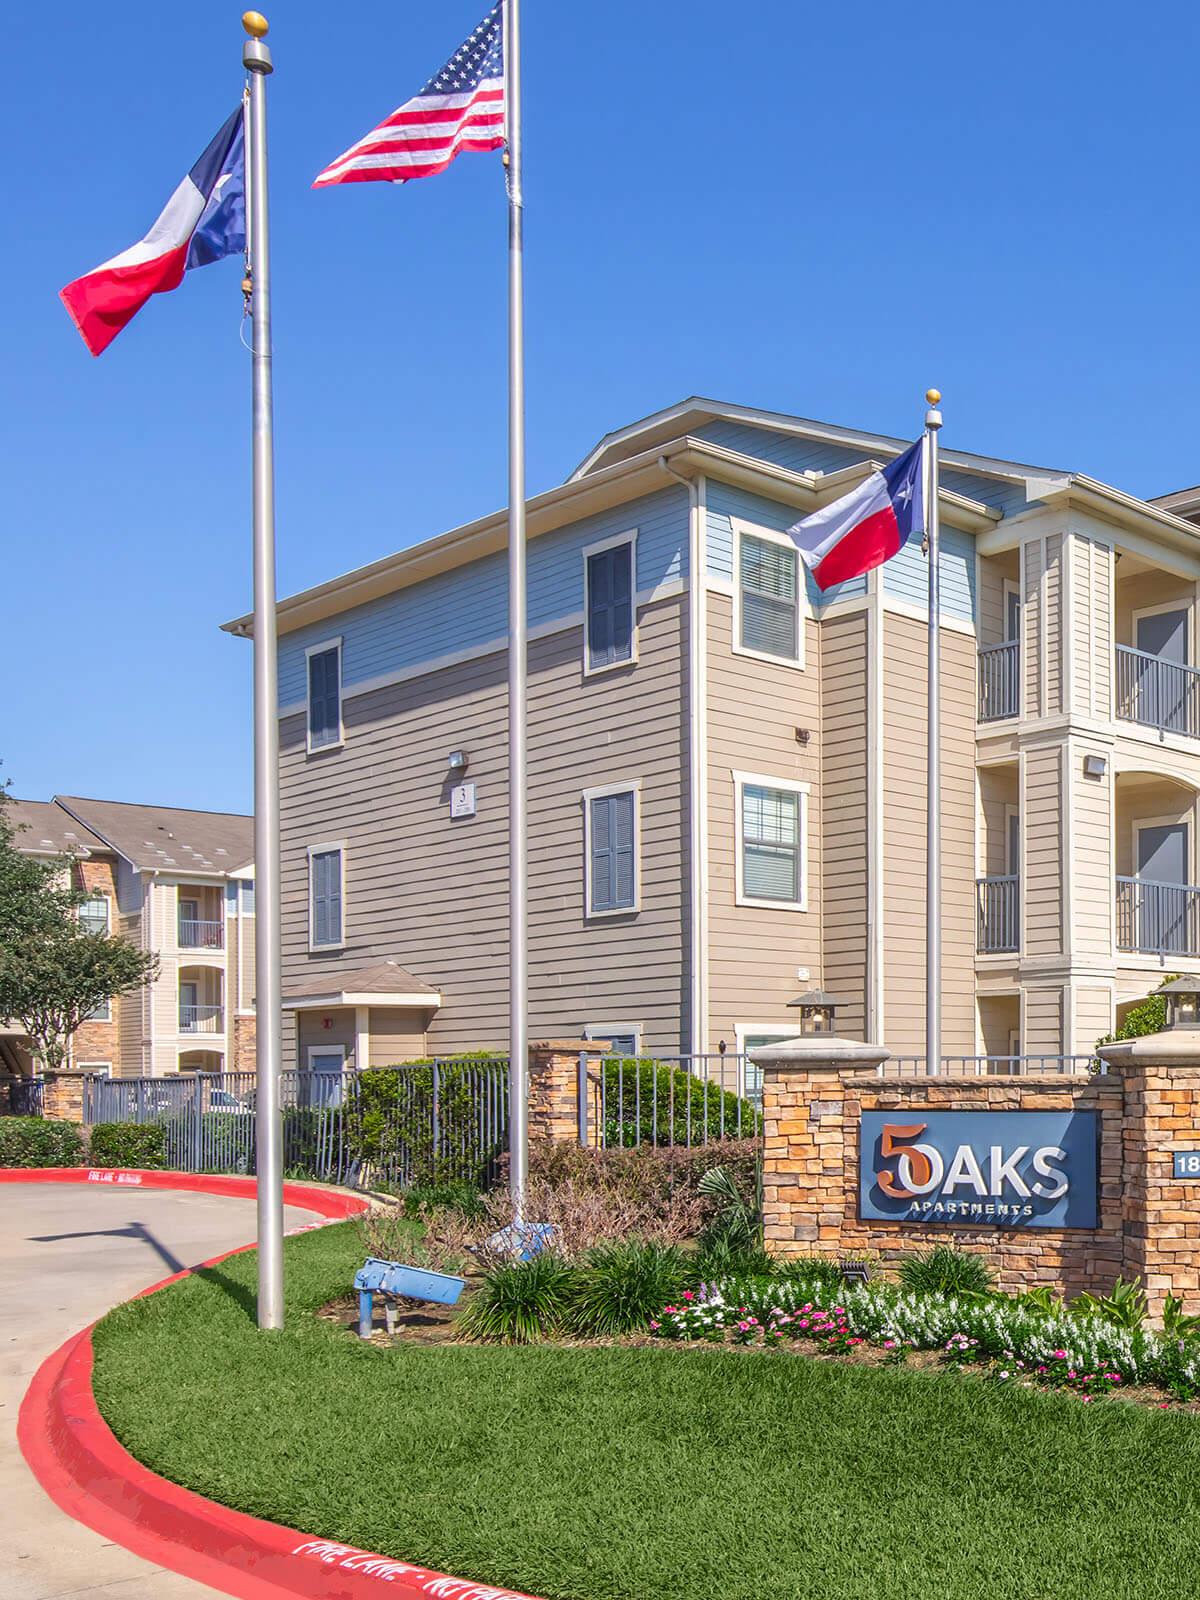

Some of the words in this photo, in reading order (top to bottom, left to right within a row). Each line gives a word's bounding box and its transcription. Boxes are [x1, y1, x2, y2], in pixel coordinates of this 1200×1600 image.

[459, 787, 466, 803] 3
[910, 1201, 1033, 1217] APARTMENTS
[292, 1541, 361, 1563] FIRE
[340, 1554, 424, 1581] LANE
